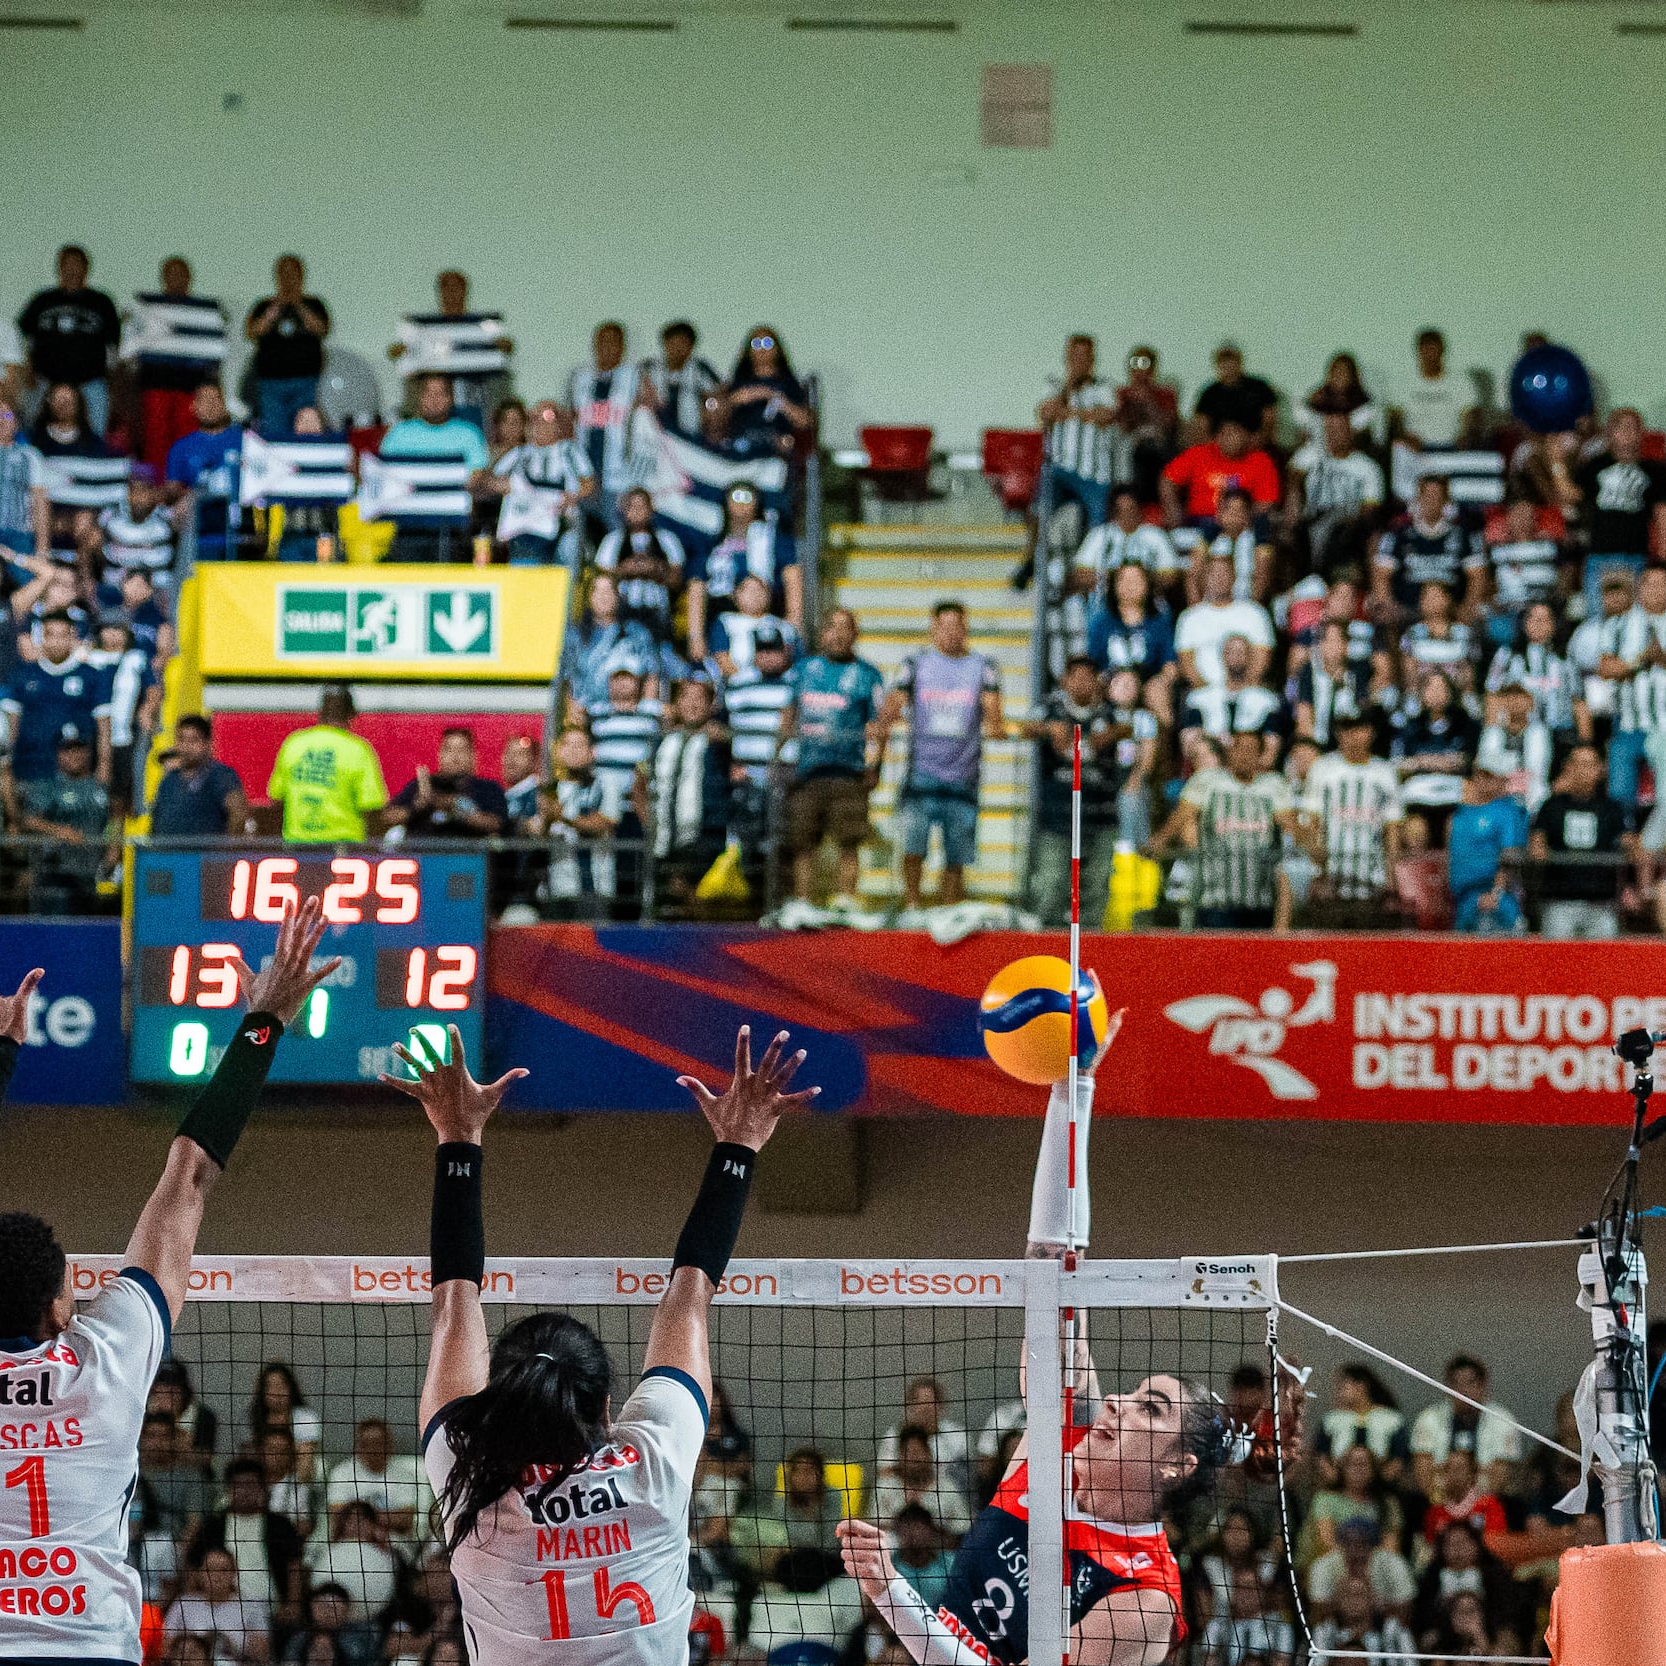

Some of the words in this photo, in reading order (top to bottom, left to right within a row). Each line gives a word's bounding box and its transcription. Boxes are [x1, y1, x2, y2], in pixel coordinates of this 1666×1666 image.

[231, 858, 299, 922] 16
[322, 858, 420, 924] 25
[170, 943, 241, 1008] 13
[406, 945, 477, 1010] 12
[307, 988, 329, 1038] 1
[1353, 992, 1605, 1041] INSTITUTO
[170, 1022, 210, 1076] 0
[1352, 1044, 1447, 1091] DEL
[73, 1264, 233, 1291] beon
[841, 1268, 1002, 1296] betsson
[1209, 1264, 1256, 1274] Senoh
[526, 1478, 630, 1525] total
[536, 1519, 632, 1562] MARIN
